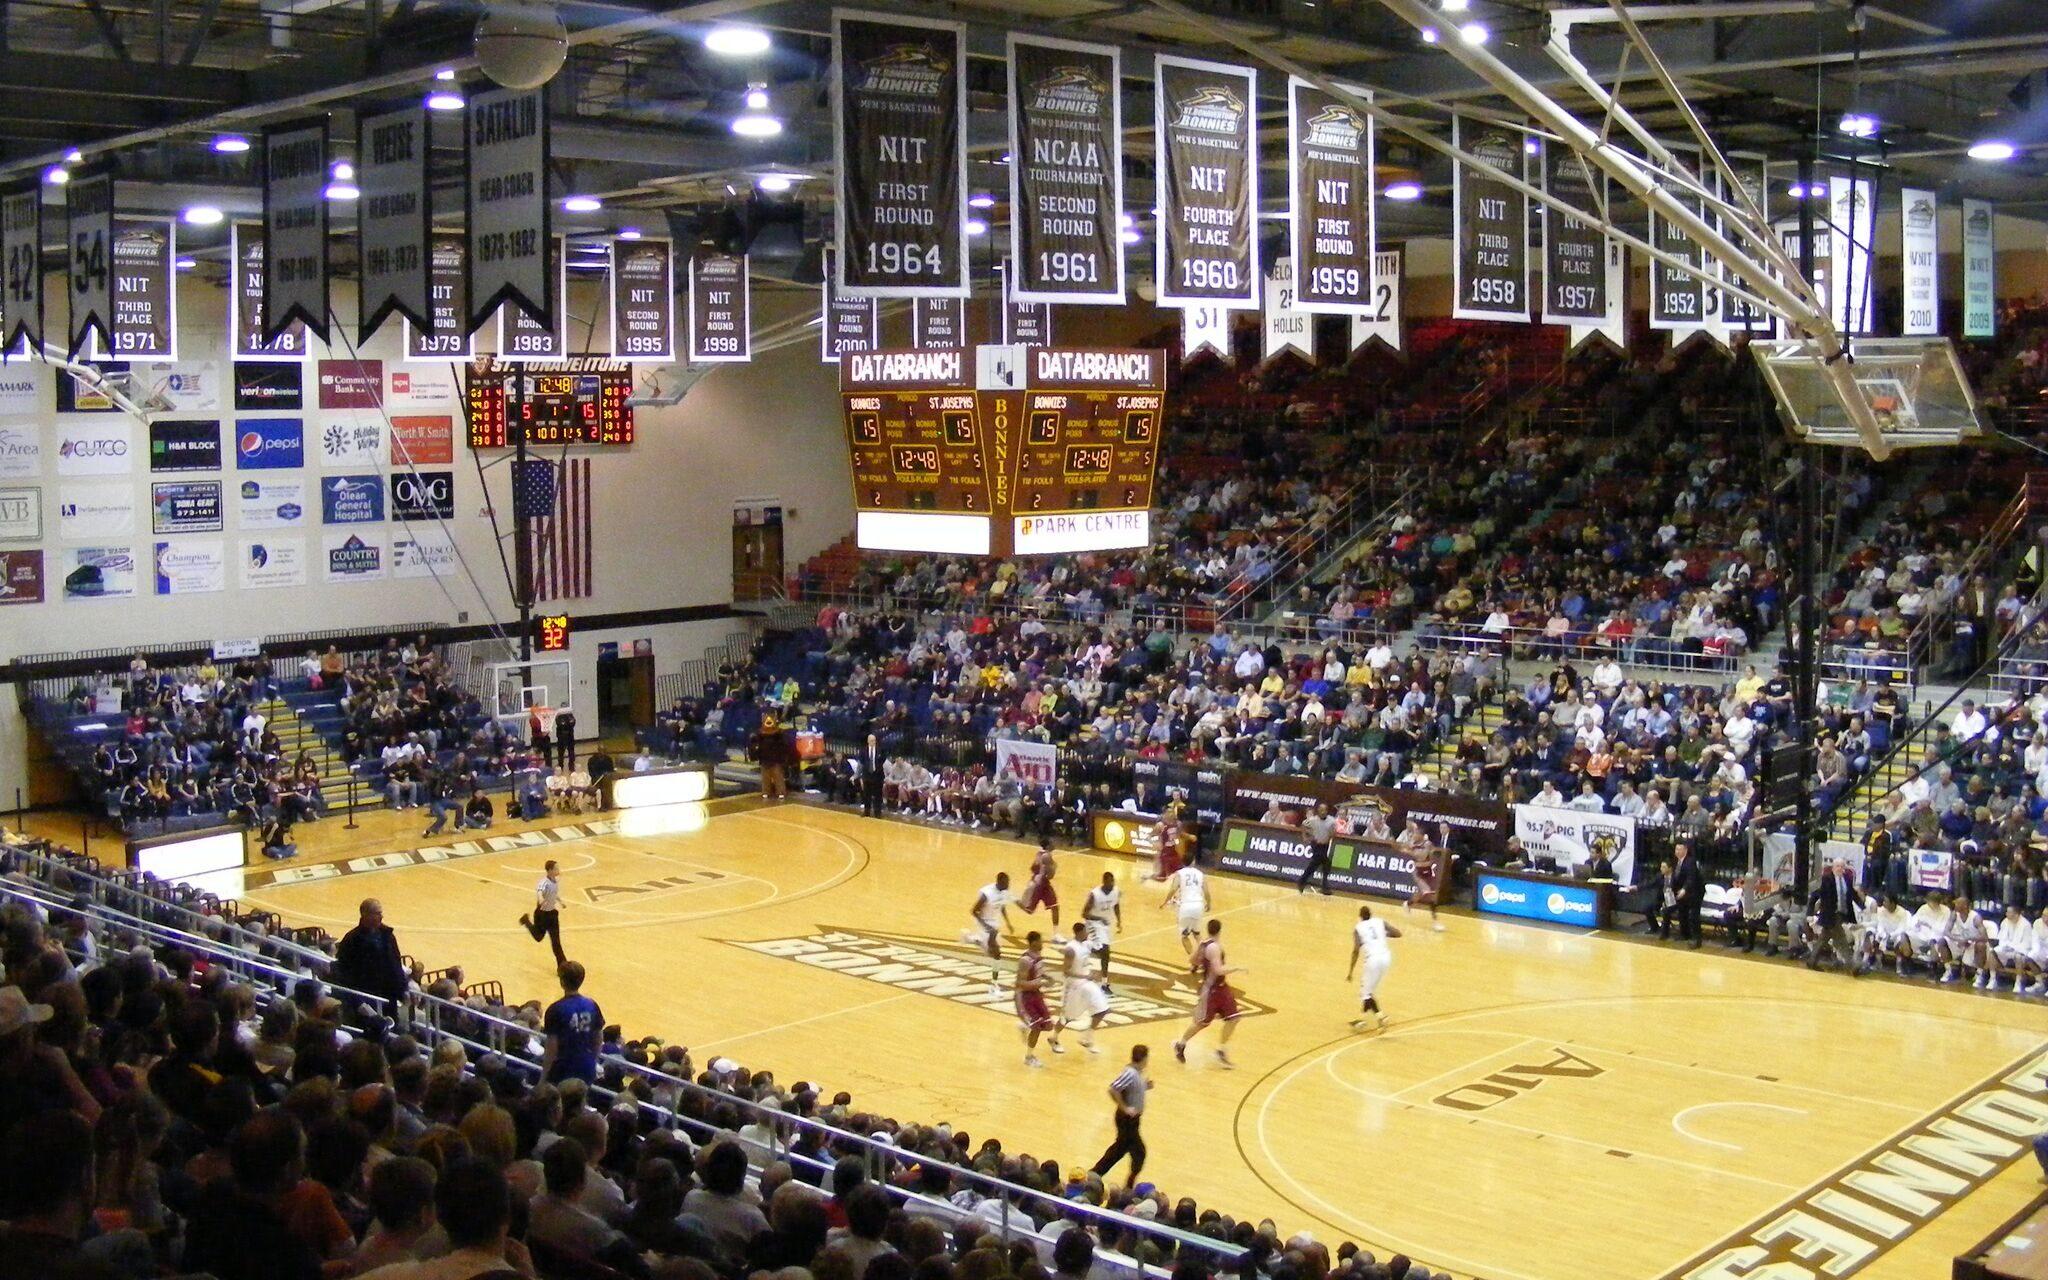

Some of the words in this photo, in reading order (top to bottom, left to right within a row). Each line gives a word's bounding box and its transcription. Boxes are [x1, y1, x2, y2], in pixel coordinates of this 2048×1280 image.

[867, 77, 940, 94] BONNIES
[888, 102, 942, 114] BASKETBALL
[1035, 96, 1098, 114] BONNIES
[475, 96, 538, 146] SATALIN
[1055, 119, 1102, 131] BASKETBALL
[1180, 115, 1236, 131] BONNIES
[1198, 137, 1239, 149] BASKETBALL
[1310, 132, 1357, 148] BONNIES
[880, 135, 927, 164] NIT
[1034, 138, 1100, 168] NCAA
[1325, 152, 1361, 164] BASKETBALL
[1030, 167, 1105, 186] TOURNAMENT
[1190, 166, 1226, 192] NIT
[879, 182, 929, 202] FIRST
[1317, 179, 1350, 205] NIT
[1039, 195, 1096, 215] SECOND
[1478, 198, 1506, 220] NIT
[874, 206, 934, 226] ROUND
[1183, 206, 1234, 226] FOURTH
[1043, 218, 1093, 236] ROUND
[1317, 218, 1350, 235] FIRST
[1189, 227, 1230, 246] PLACE
[1478, 233, 1508, 250] THIRD
[1315, 238, 1353, 255] ROUND
[1558, 242, 1594, 258] FOURTH
[75, 229, 107, 293] 54
[868, 242, 942, 274] 1964
[1477, 251, 1509, 267] PLACE
[9, 243, 33, 302] 42
[1040, 252, 1098, 282] 1961
[1183, 259, 1238, 289] 1960
[1562, 262, 1591, 275] PLACE
[119, 277, 150, 292] NIT
[1311, 267, 1359, 295] 1959
[631, 290, 655, 302] NIT
[709, 292, 731, 304] NIT
[1471, 277, 1515, 304] 1958
[1557, 285, 1595, 309] 1957
[118, 301, 152, 312] THIRD
[930, 299, 949, 310] NIT
[1018, 303, 1036, 313] NIT
[1663, 293, 1695, 314] 1952
[117, 313, 153, 325] PLACE
[627, 311, 659, 320] SECOND
[708, 312, 731, 321] FIRST
[840, 315, 860, 323] FIRST
[930, 317, 949, 326] FIRST
[1909, 310, 1932, 327] 2010
[629, 321, 658, 331] ROUND
[707, 321, 734, 331] ROUND
[839, 324, 863, 333] ROUND
[1273, 317, 1304, 333] HOLLIS
[114, 332, 156, 350] 1971
[514, 336, 552, 351] 1983
[626, 338, 662, 352] 1995
[703, 338, 738, 352] 1998
[524, 357, 629, 373] ONAVENTURE
[851, 352, 960, 382] DATABRANCH
[1037, 351, 1149, 381] DATABRANCH
[335, 384, 355, 393] Bank
[540, 378, 571, 394] 12:48
[582, 403, 594, 418] 15
[850, 398, 881, 410] BONNIES
[1033, 396, 1067, 410] BONNIES
[522, 404, 531, 420] 5
[427, 426, 449, 438] Smith
[863, 418, 876, 438] 15
[956, 418, 971, 438] 15
[1041, 418, 1055, 437] 15
[1067, 420, 1088, 428] BONUS
[1136, 417, 1149, 437] 15
[8, 444, 39, 455] Area
[74, 439, 127, 457] CUTCO
[168, 442, 187, 450] H&R
[188, 441, 215, 450] BLOCK
[265, 437, 299, 450] pepsi
[855, 452, 861, 466] 5
[901, 450, 936, 470] 12:48
[994, 399, 1007, 505] BONNIES
[1073, 449, 1109, 469] 12:48
[1144, 451, 1150, 465] 5
[974, 453, 981, 468] 5
[1022, 453, 1029, 468] 5
[340, 491, 366, 500] Olean
[397, 480, 447, 507] OMG
[874, 491, 881, 505] 2
[966, 494, 973, 508] 2
[1033, 493, 1041, 508] 2
[1127, 490, 1134, 504] 2
[335, 500, 372, 510] General
[335, 511, 372, 521] Hospital
[1035, 517, 1076, 534] PARK
[1085, 513, 1142, 532] CENTRE
[333, 549, 378, 561] COUNTRY
[543, 617, 566, 629] 12:48
[545, 629, 563, 649] 32
[1526, 821, 1544, 834] 95.7
[1557, 825, 1575, 837] PIG
[1584, 824, 1627, 838] BONNIES
[1249, 836, 1277, 853] H&R
[1279, 840, 1314, 858] BLOC
[1222, 855, 1243, 866] OLEAN
[1245, 859, 1278, 873] BRADFORD
[1357, 852, 1386, 869] H&R
[1186, 873, 1199, 887] 24
[1357, 877, 1391, 890] GOWANDA
[1499, 890, 1526, 904] pepsi
[1565, 900, 1592, 914] pepsi
